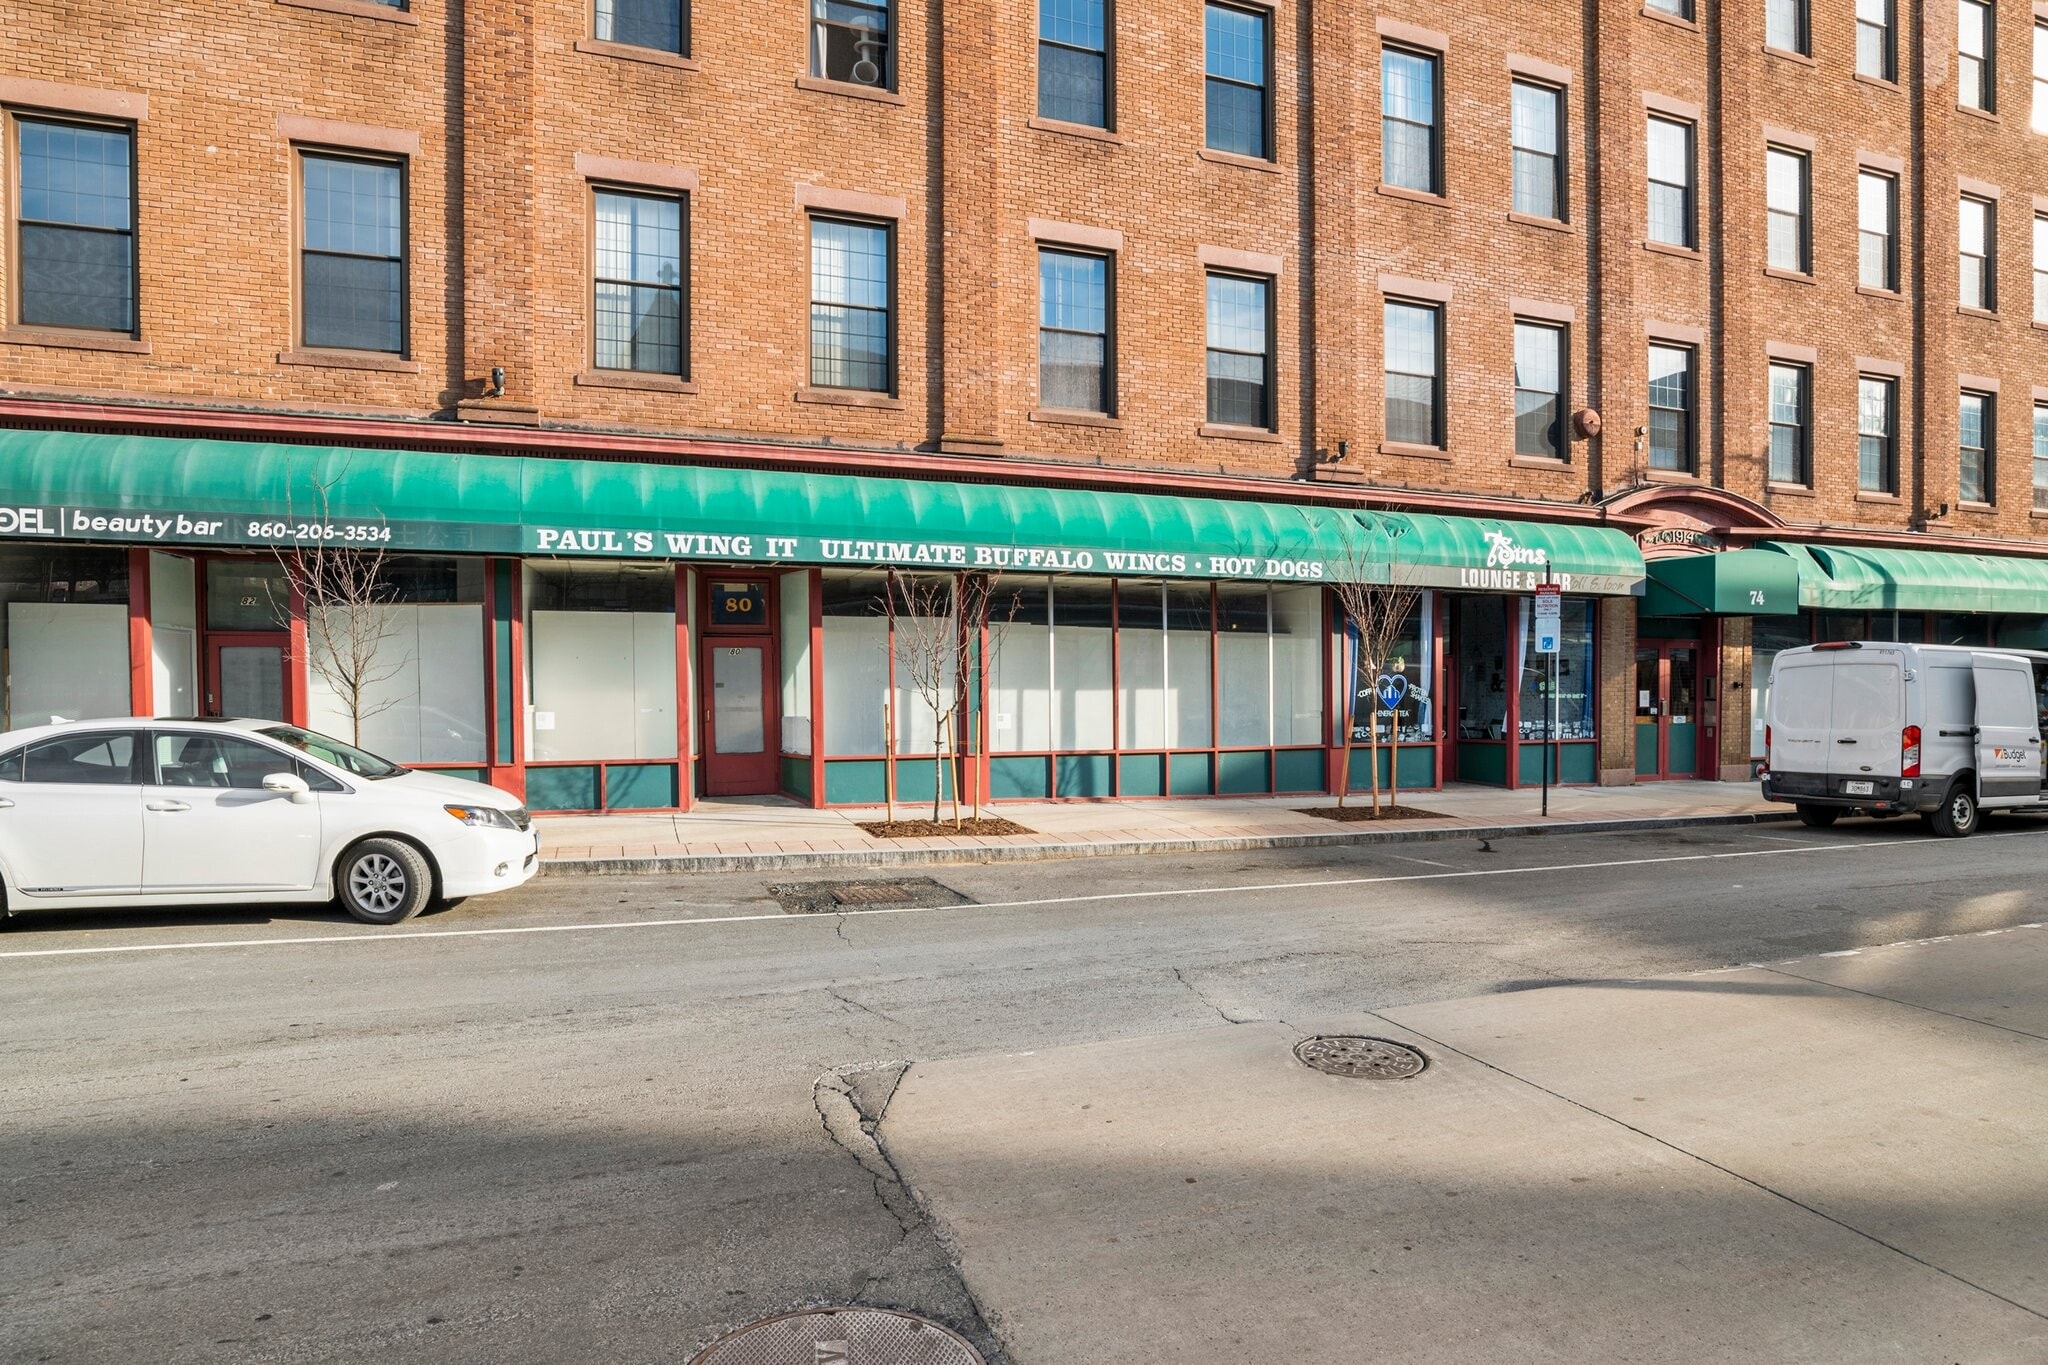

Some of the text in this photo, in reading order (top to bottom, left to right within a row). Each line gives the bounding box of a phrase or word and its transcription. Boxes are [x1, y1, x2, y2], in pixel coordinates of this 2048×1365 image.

[72, 510, 173, 539] beauty
[176, 514, 223, 536] bar
[248, 521, 392, 542] 860-206-3534
[536, 528, 1323, 579] PAUL'S WING IT ULTIMATE BUFFALO WINGS HOT DOGS
[1461, 567, 1521, 590] LOUNGE
[1526, 571, 1537, 591] &
[241, 597, 256, 606] 82
[725, 597, 752, 613] 80
[1749, 590, 1765, 606] 74
[729, 647, 741, 656] 80
[2002, 748, 2027, 763] Budget
